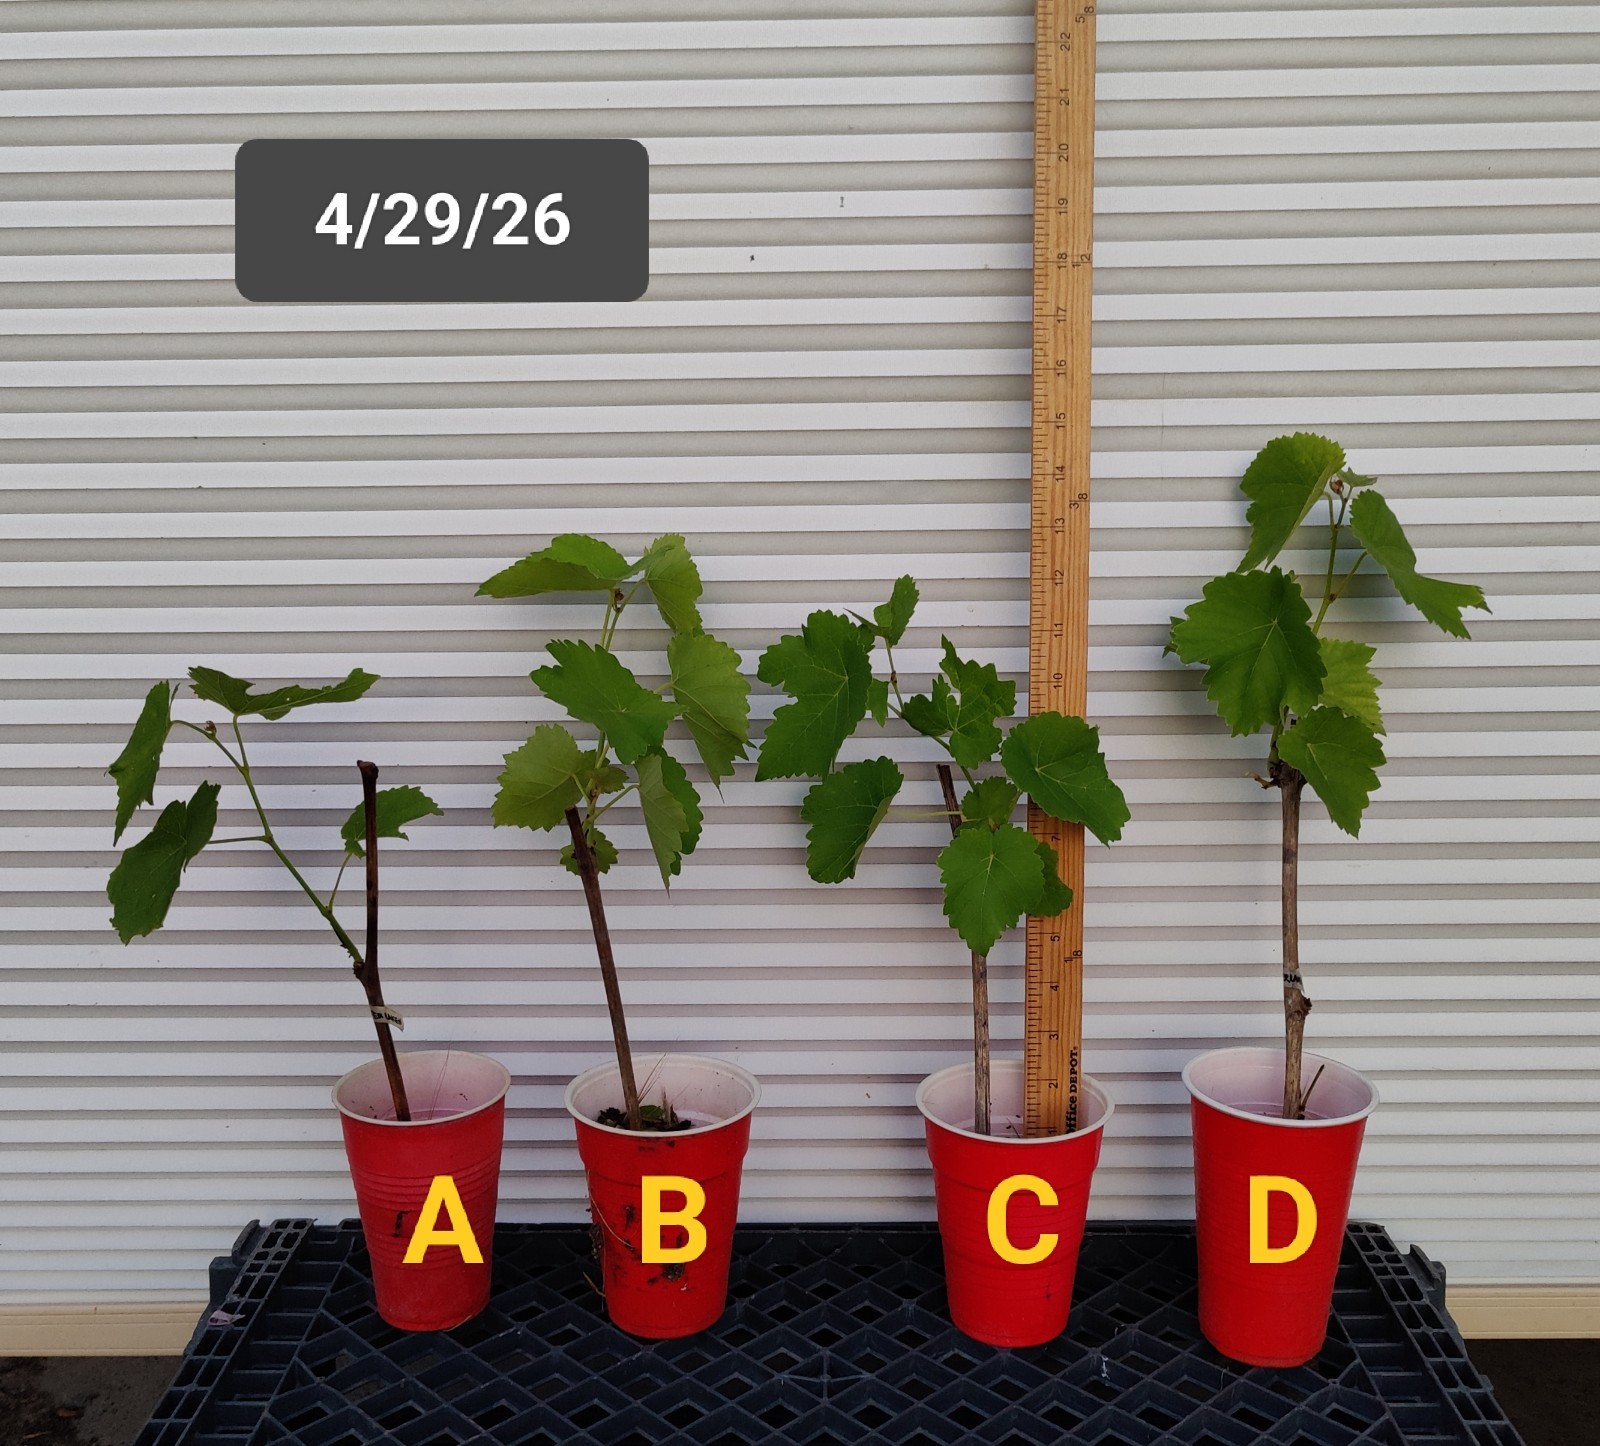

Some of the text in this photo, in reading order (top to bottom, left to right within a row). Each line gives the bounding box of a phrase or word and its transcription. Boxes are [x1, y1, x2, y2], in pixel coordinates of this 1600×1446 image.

[1060, 31, 1070, 51] 22
[1059, 88, 1069, 107] 21
[1058, 143, 1069, 162] 20
[1058, 198, 1068, 216] 19
[1057, 252, 1067, 270] 18
[1056, 306, 1066, 324] 17
[1056, 359, 1066, 377] 16
[1055, 412, 1065, 430] 15
[1055, 465, 1065, 482] 14
[1055, 517, 1065, 534] 13
[1055, 569, 1064, 586] 12
[1054, 622, 1063, 638] 11
[1053, 673, 1062, 690] 10
